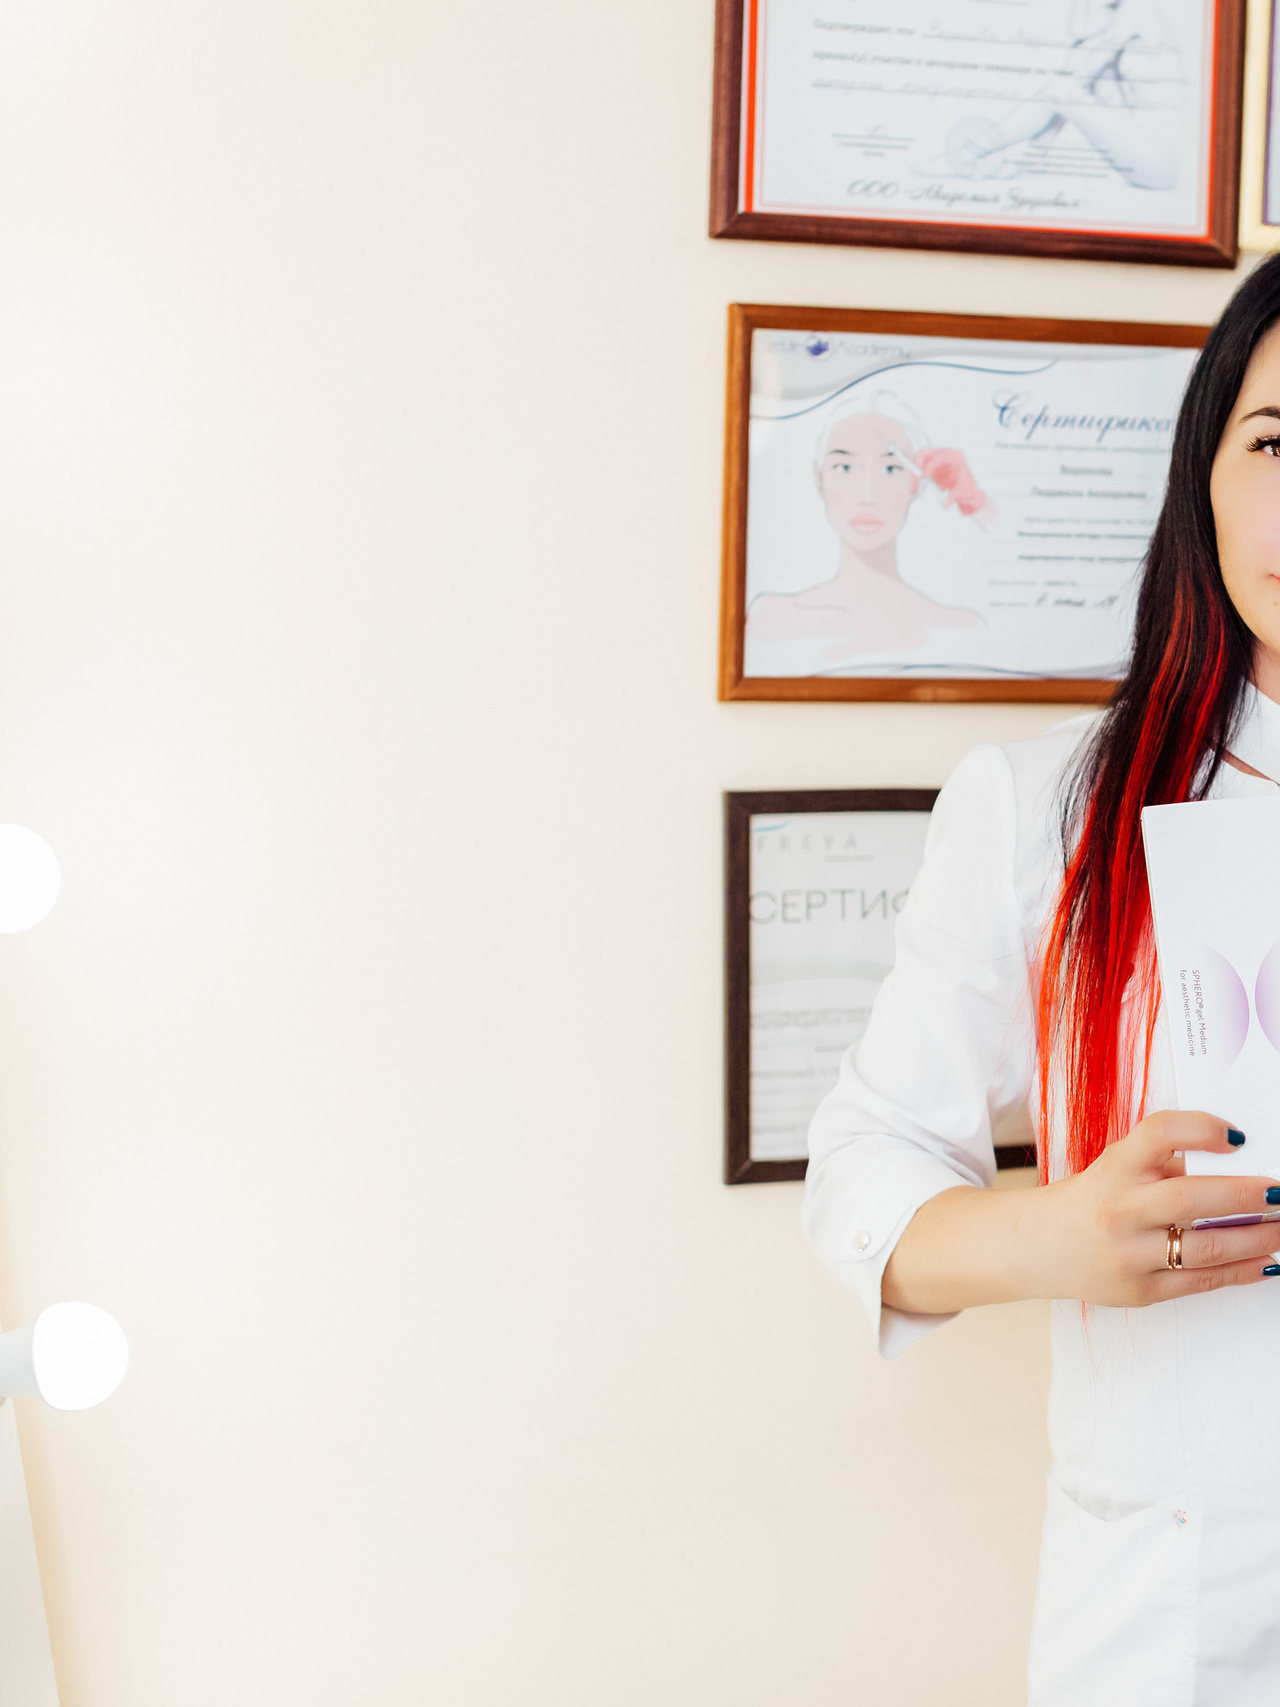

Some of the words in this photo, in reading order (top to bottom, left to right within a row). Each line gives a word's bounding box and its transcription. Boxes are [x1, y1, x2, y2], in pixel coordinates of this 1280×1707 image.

[992, 388, 1172, 443] Сертифика
[1180, 969, 1188, 981] for
[1181, 982, 1190, 1018] aesthetic
[1186, 1020, 1195, 1056] medicine
[1198, 1022, 1208, 1055] Medium
